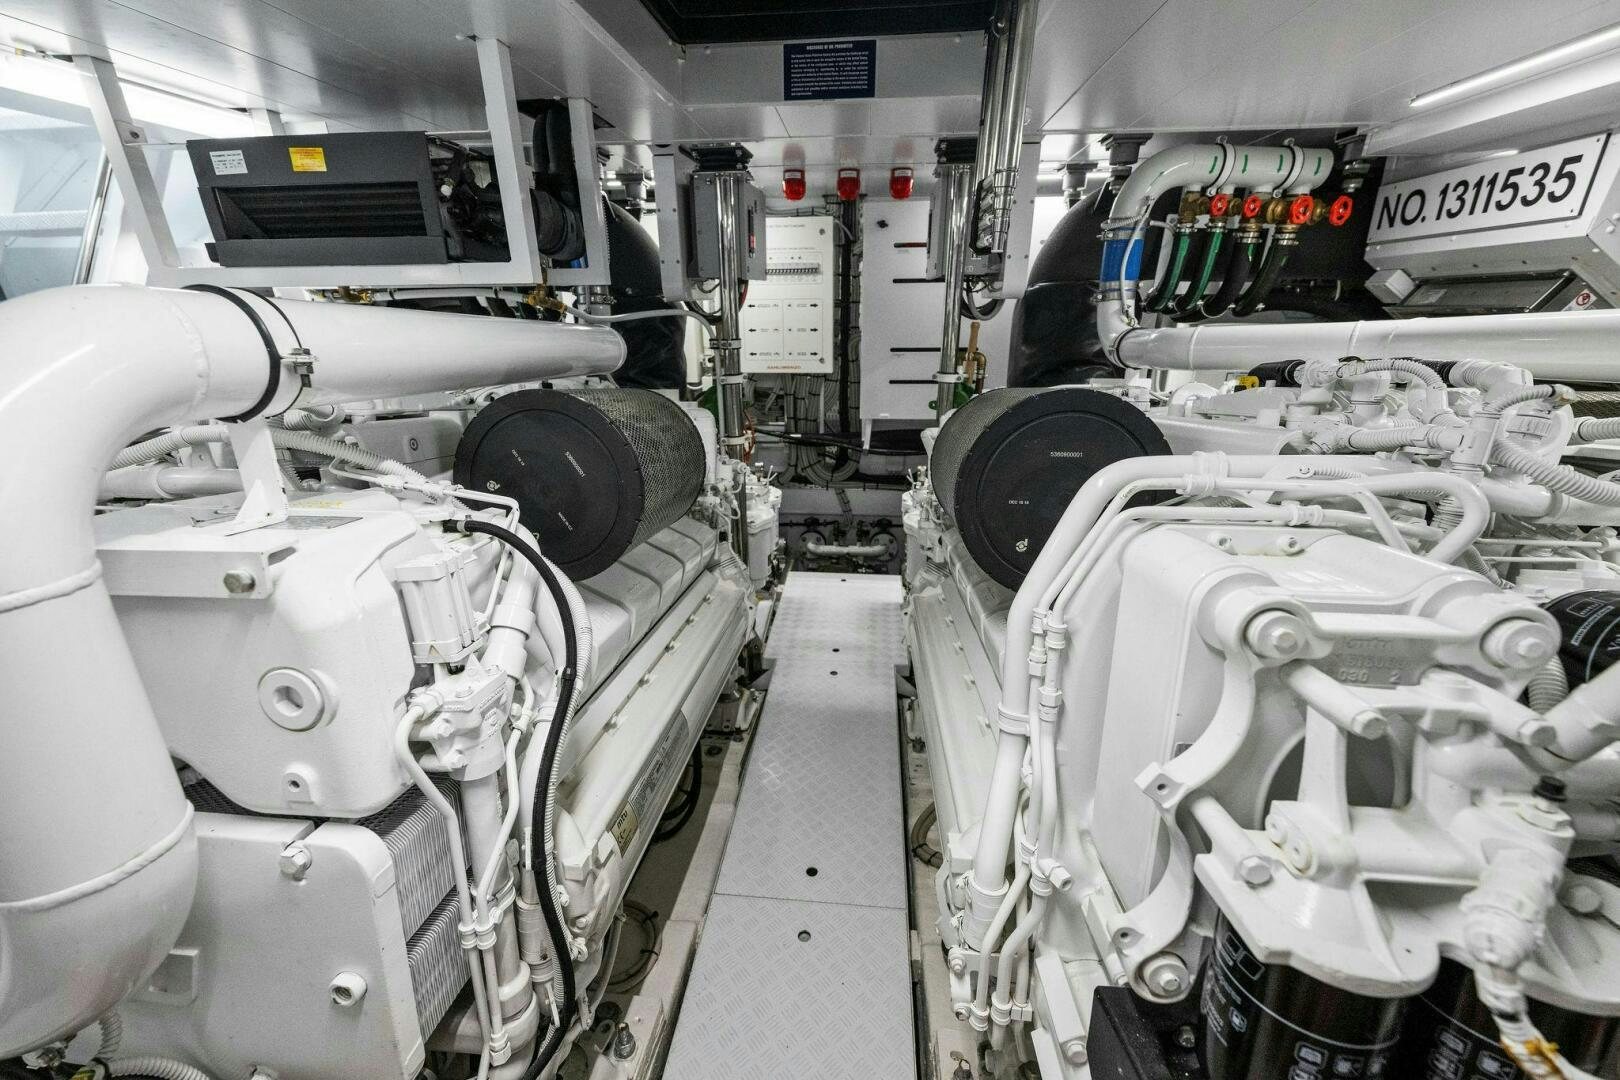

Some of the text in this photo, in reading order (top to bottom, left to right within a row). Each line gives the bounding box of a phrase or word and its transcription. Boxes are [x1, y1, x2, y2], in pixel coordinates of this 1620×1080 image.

[1376, 154, 1584, 230] NO. 1311535
[616, 810, 628, 828] mtu
